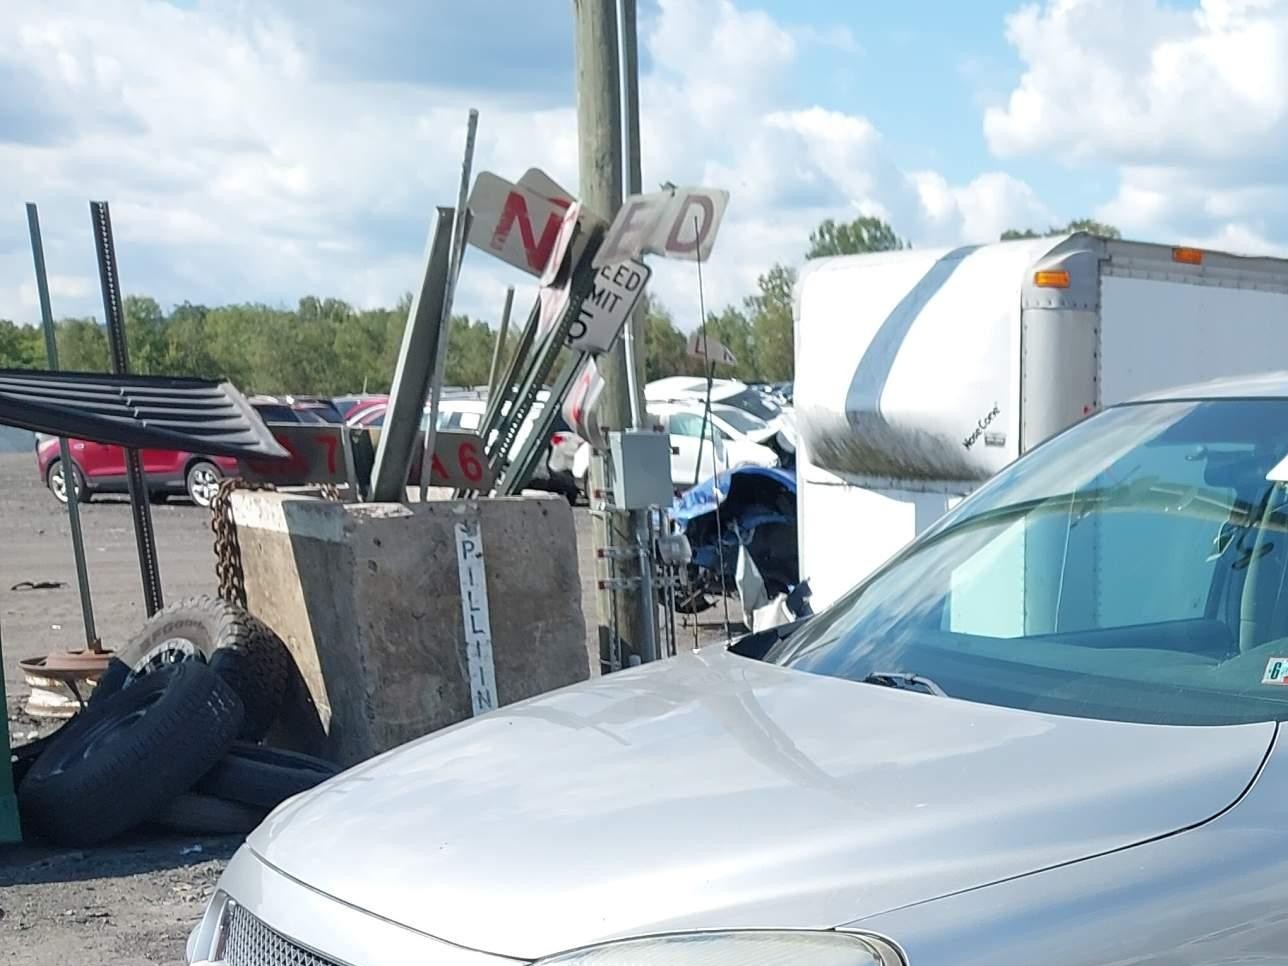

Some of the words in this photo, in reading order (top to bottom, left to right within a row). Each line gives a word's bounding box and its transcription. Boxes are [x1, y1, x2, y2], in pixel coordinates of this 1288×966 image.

[665, 195, 714, 253] D
[600, 264, 641, 291] EED
[592, 288, 623, 313] MIT
[1270, 662, 1282, 680] 6
